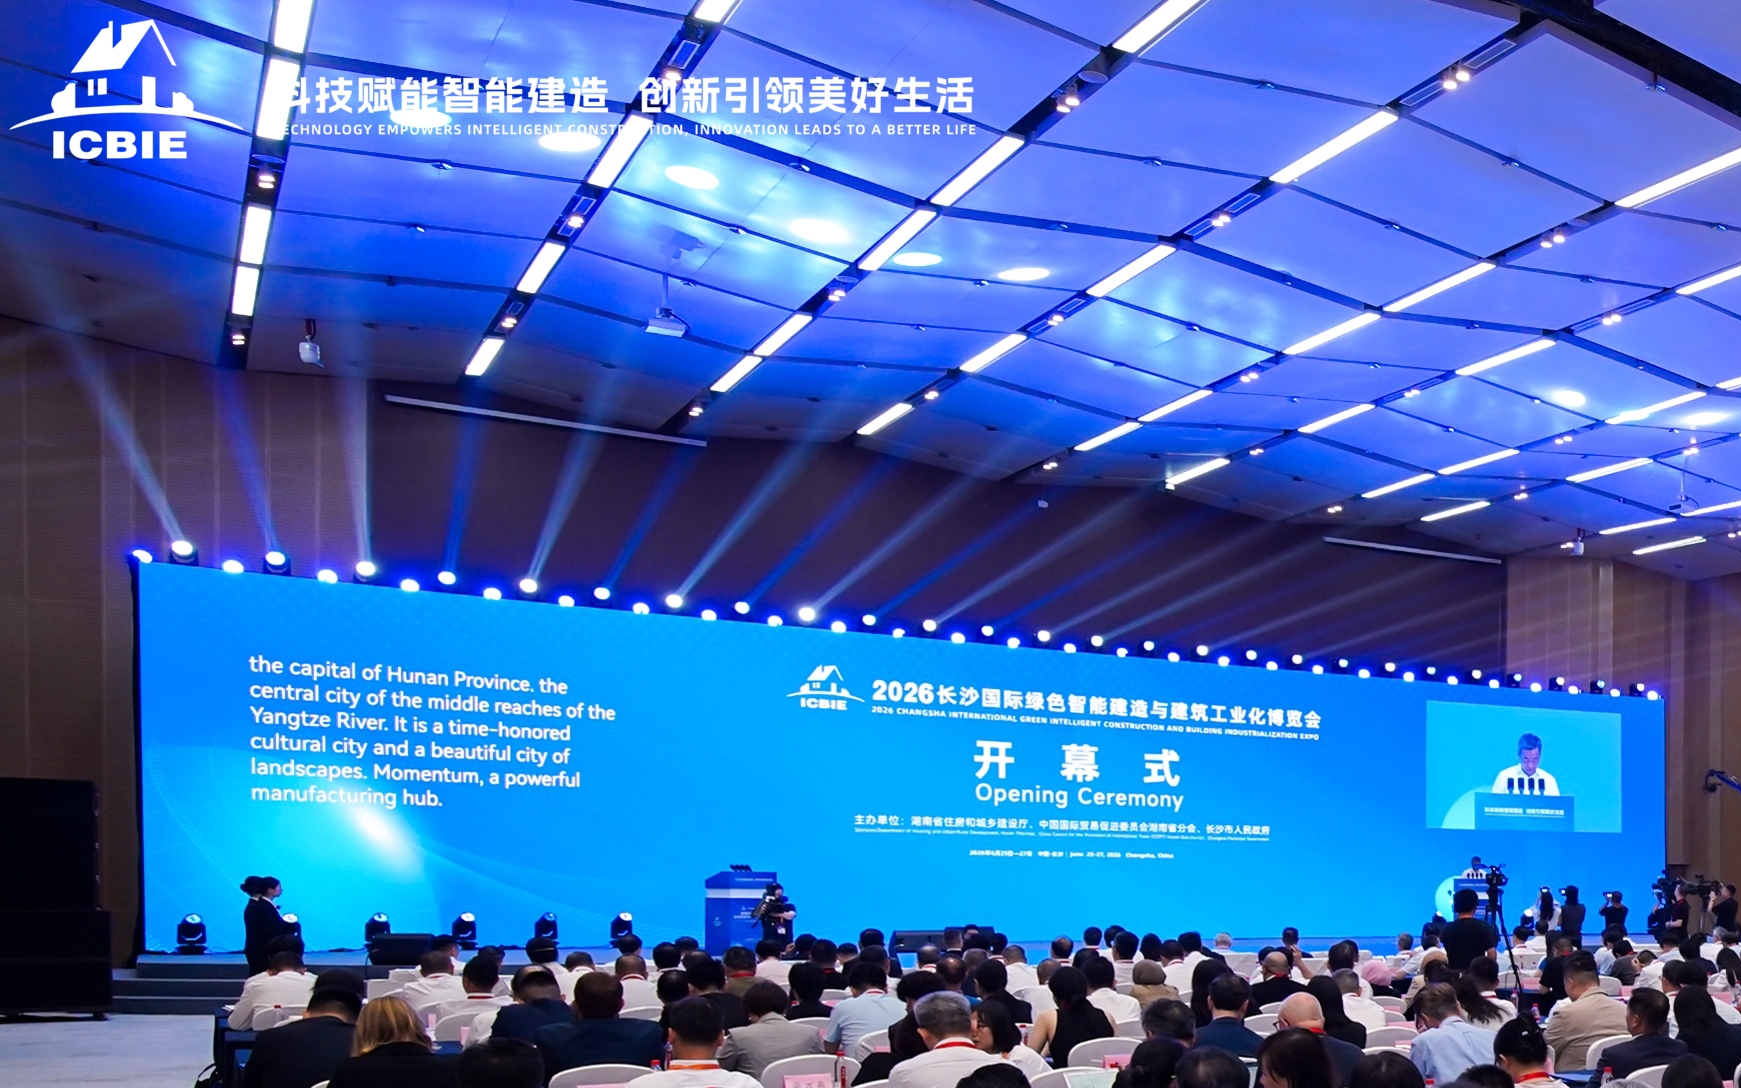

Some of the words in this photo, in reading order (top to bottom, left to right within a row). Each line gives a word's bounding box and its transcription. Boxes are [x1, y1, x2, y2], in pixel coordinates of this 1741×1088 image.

[248, 654, 284, 675] the
[288, 660, 356, 682] capital
[361, 663, 383, 681] of
[386, 665, 449, 687] Hunan
[453, 670, 535, 693] Province.
[538, 677, 569, 695] the
[248, 684, 320, 702] central
[324, 686, 362, 709] city
[365, 688, 388, 707] of
[390, 689, 423, 709] the
[427, 693, 490, 713] middle
[493, 699, 563, 718] reaches
[565, 701, 585, 719] of
[587, 703, 617, 721] the
[799, 697, 848, 711] ICBIE
[871, 679, 1322, 730] 2026长沙国际绿色智能建造与建筑工业化博览会
[249, 705, 332, 731] Yangtze
[335, 711, 389, 732] River.
[393, 714, 409, 733] It
[412, 715, 428, 734] is
[431, 721, 444, 735] a
[447, 718, 571, 742] time-honored
[871, 705, 894, 715] 2026
[895, 707, 947, 718] CHANGSHA
[948, 711, 1018, 723] INTERNATIONAL
[1019, 715, 1048, 724] GREEN
[1049, 717, 1102, 727] INTELLIGENT
[1103, 720, 1165, 732] CONSTRUCTION
[1166, 724, 1185, 733] AND
[1185, 725, 1223, 735] BUILDING
[1224, 728, 1299, 739] INDUSTRIALIZATION
[1299, 732, 1320, 741] EXPO
[249, 732, 327, 753] cultural
[331, 736, 368, 760] city
[372, 739, 409, 757] and
[413, 744, 426, 758] a
[430, 740, 512, 762] beautiful
[515, 746, 549, 768] city
[551, 747, 572, 765] of
[974, 739, 1181, 788] 开幕式
[250, 756, 368, 783] landscapes.
[372, 763, 485, 787] Momentum,
[488, 772, 500, 785] a
[503, 770, 581, 790] powerful
[250, 784, 397, 810] manufacturing
[401, 788, 443, 807] hub.
[974, 782, 1069, 809] Opening
[1077, 786, 1185, 813] Ceremony
